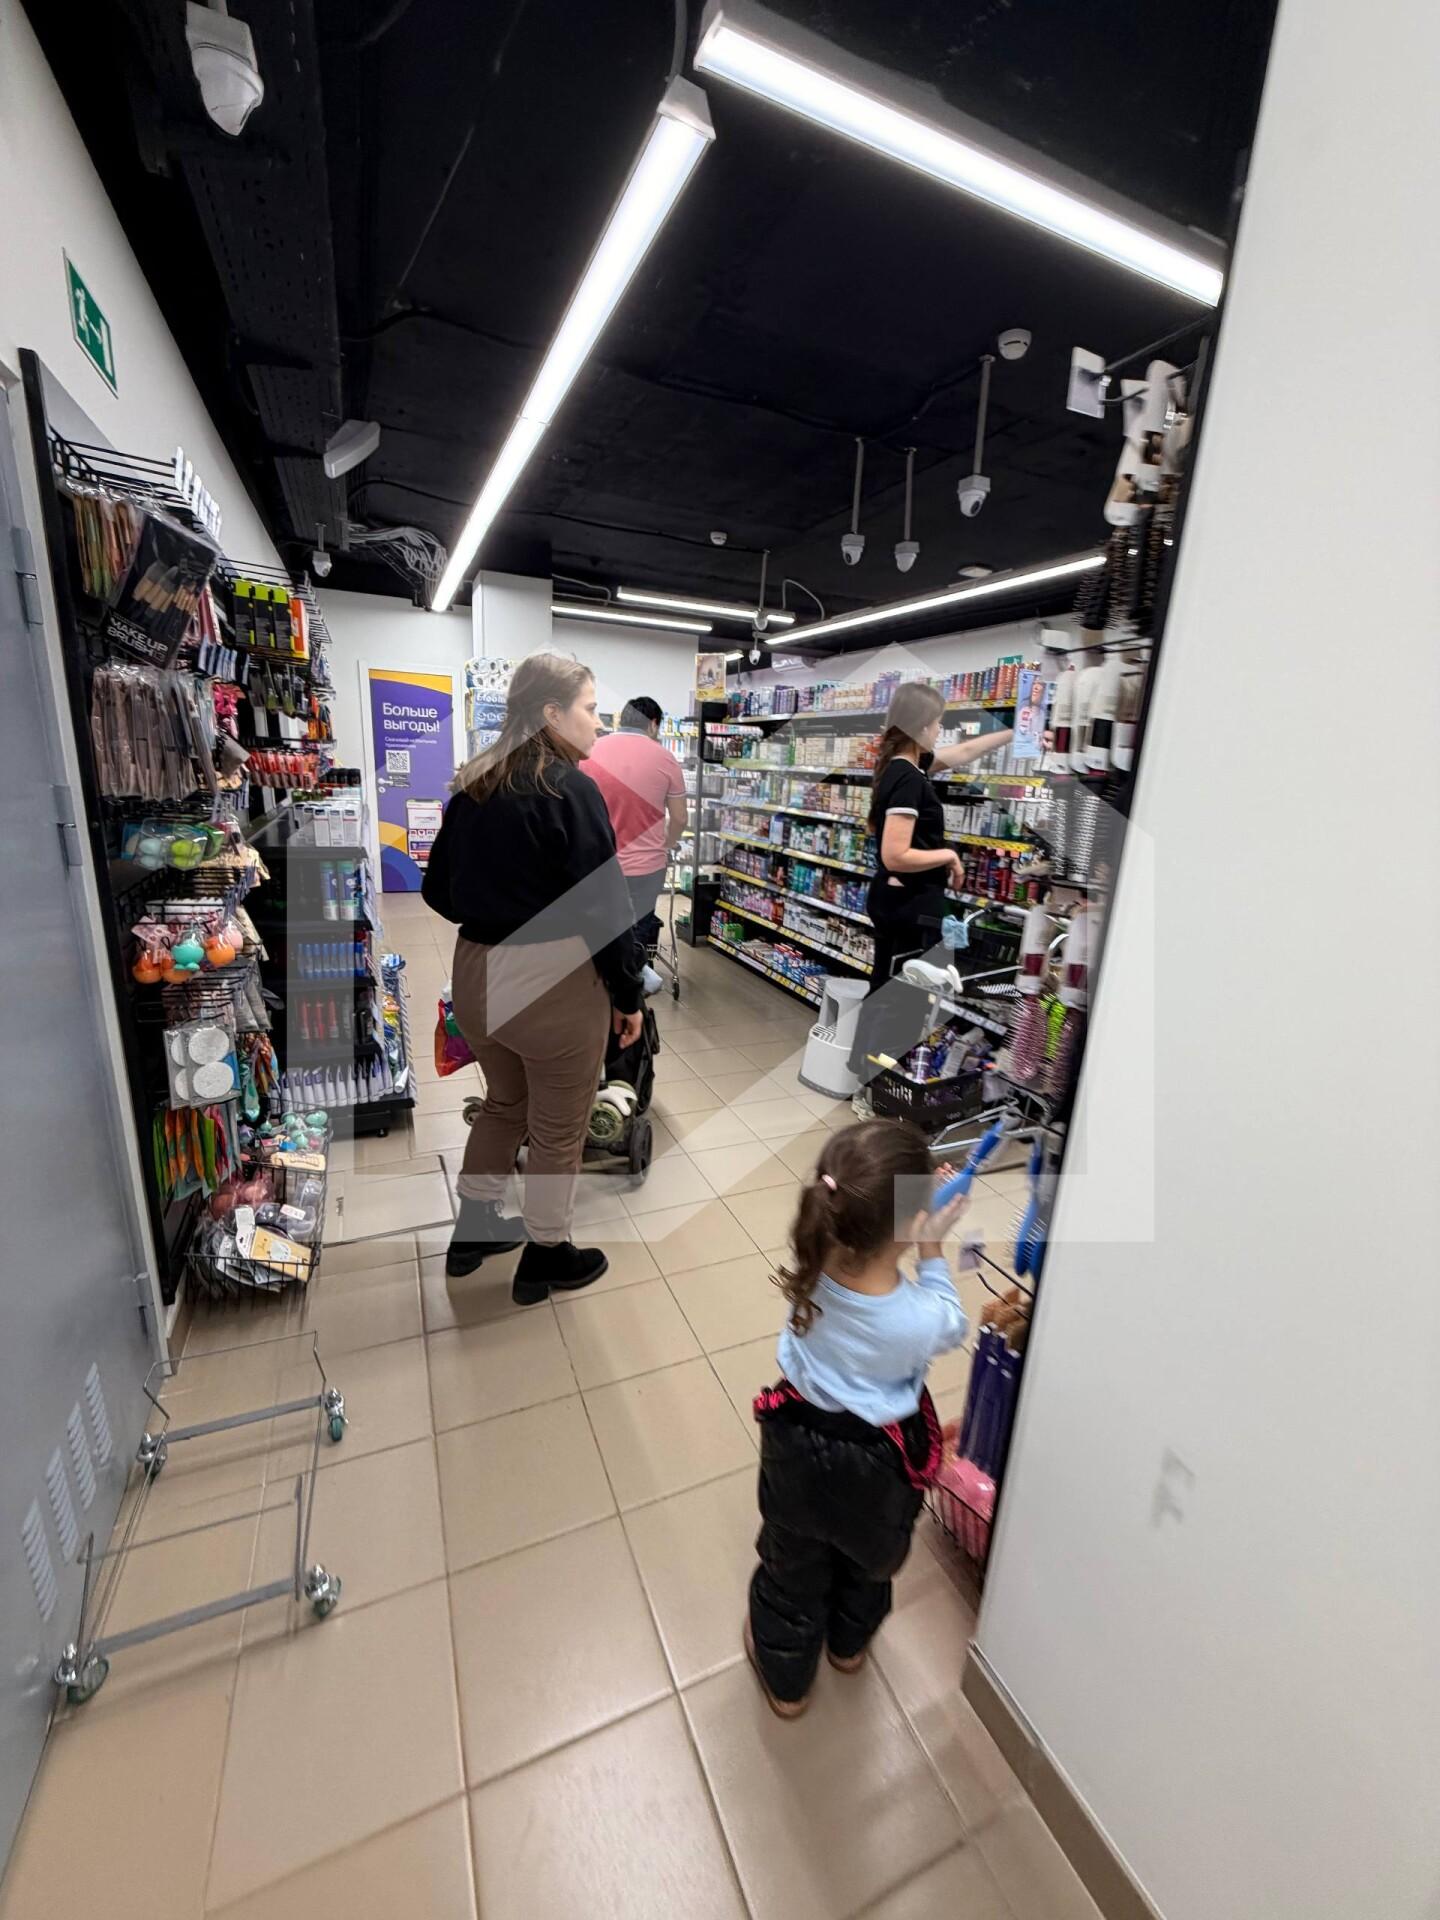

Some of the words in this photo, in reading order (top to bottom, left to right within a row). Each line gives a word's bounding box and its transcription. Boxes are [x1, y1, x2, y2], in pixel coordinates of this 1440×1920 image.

[107, 626, 154, 656] BRUSH
[382, 702, 438, 719] Больше
[383, 720, 440, 733] выгоды!
